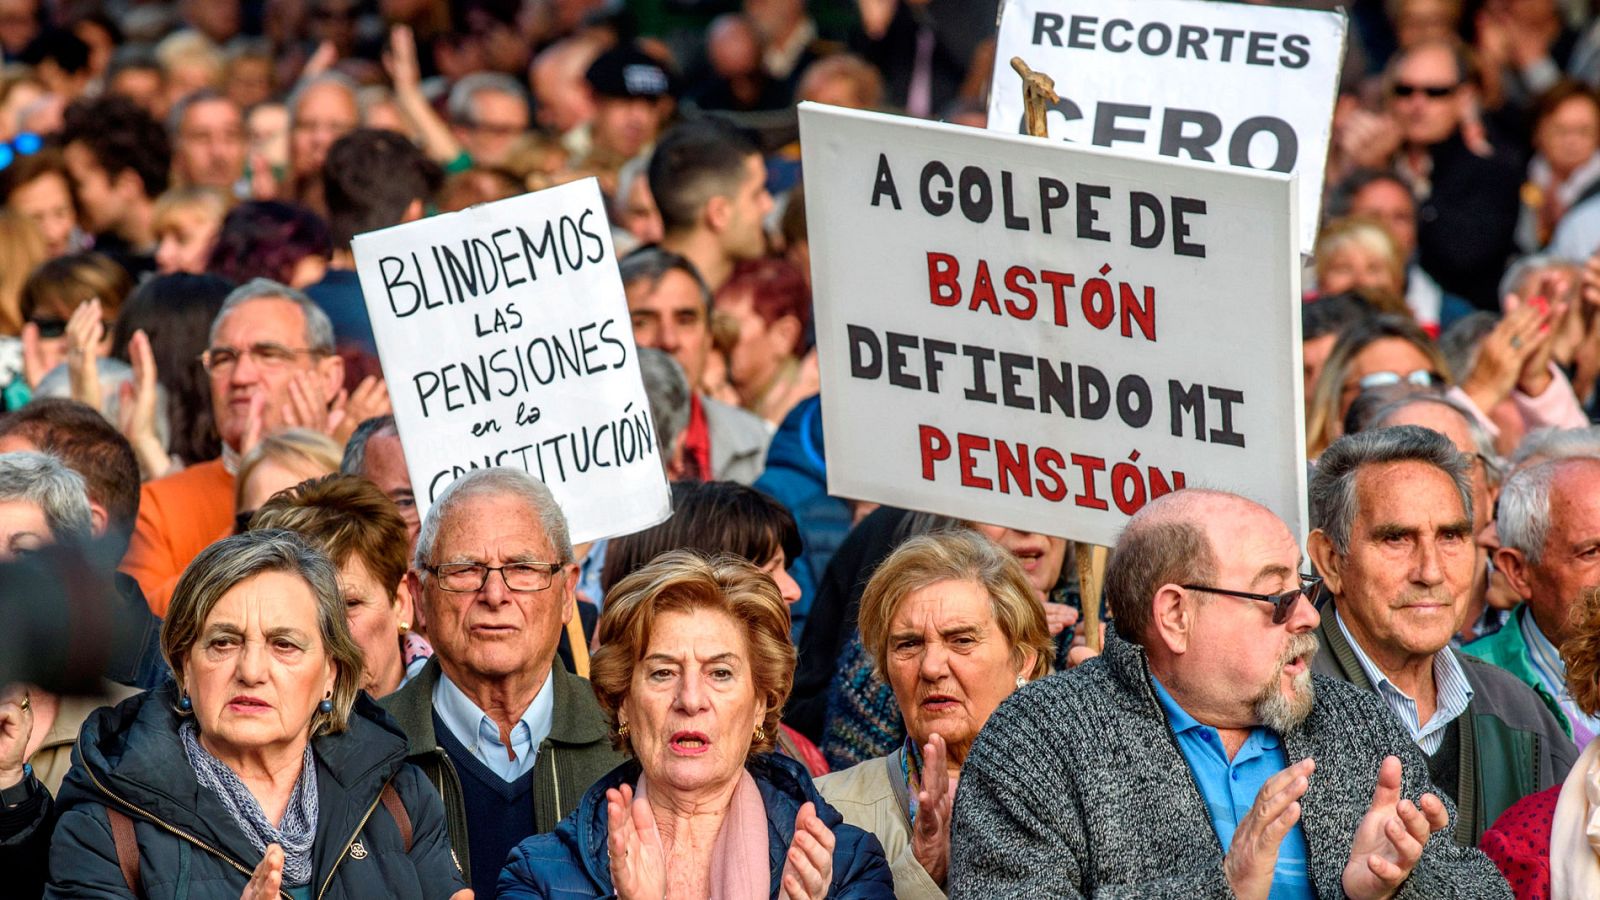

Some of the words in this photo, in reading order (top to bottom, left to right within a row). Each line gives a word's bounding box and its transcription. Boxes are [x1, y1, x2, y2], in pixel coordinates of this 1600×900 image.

[1031, 12, 1311, 69] RECORTES
[871, 153, 902, 210] A
[919, 160, 1111, 242] GOLPE
[1129, 190, 1207, 258] DE
[378, 208, 604, 318] BLINDEMOS
[926, 251, 1157, 342] BASTÓN
[412, 319, 626, 418] PENSIONES
[474, 303, 523, 338] LAS
[470, 418, 502, 437] en
[515, 402, 541, 426] la
[846, 324, 1153, 429] DEFIENDO
[1168, 379, 1246, 448] MI
[429, 402, 652, 504] CTITUCIÓN
